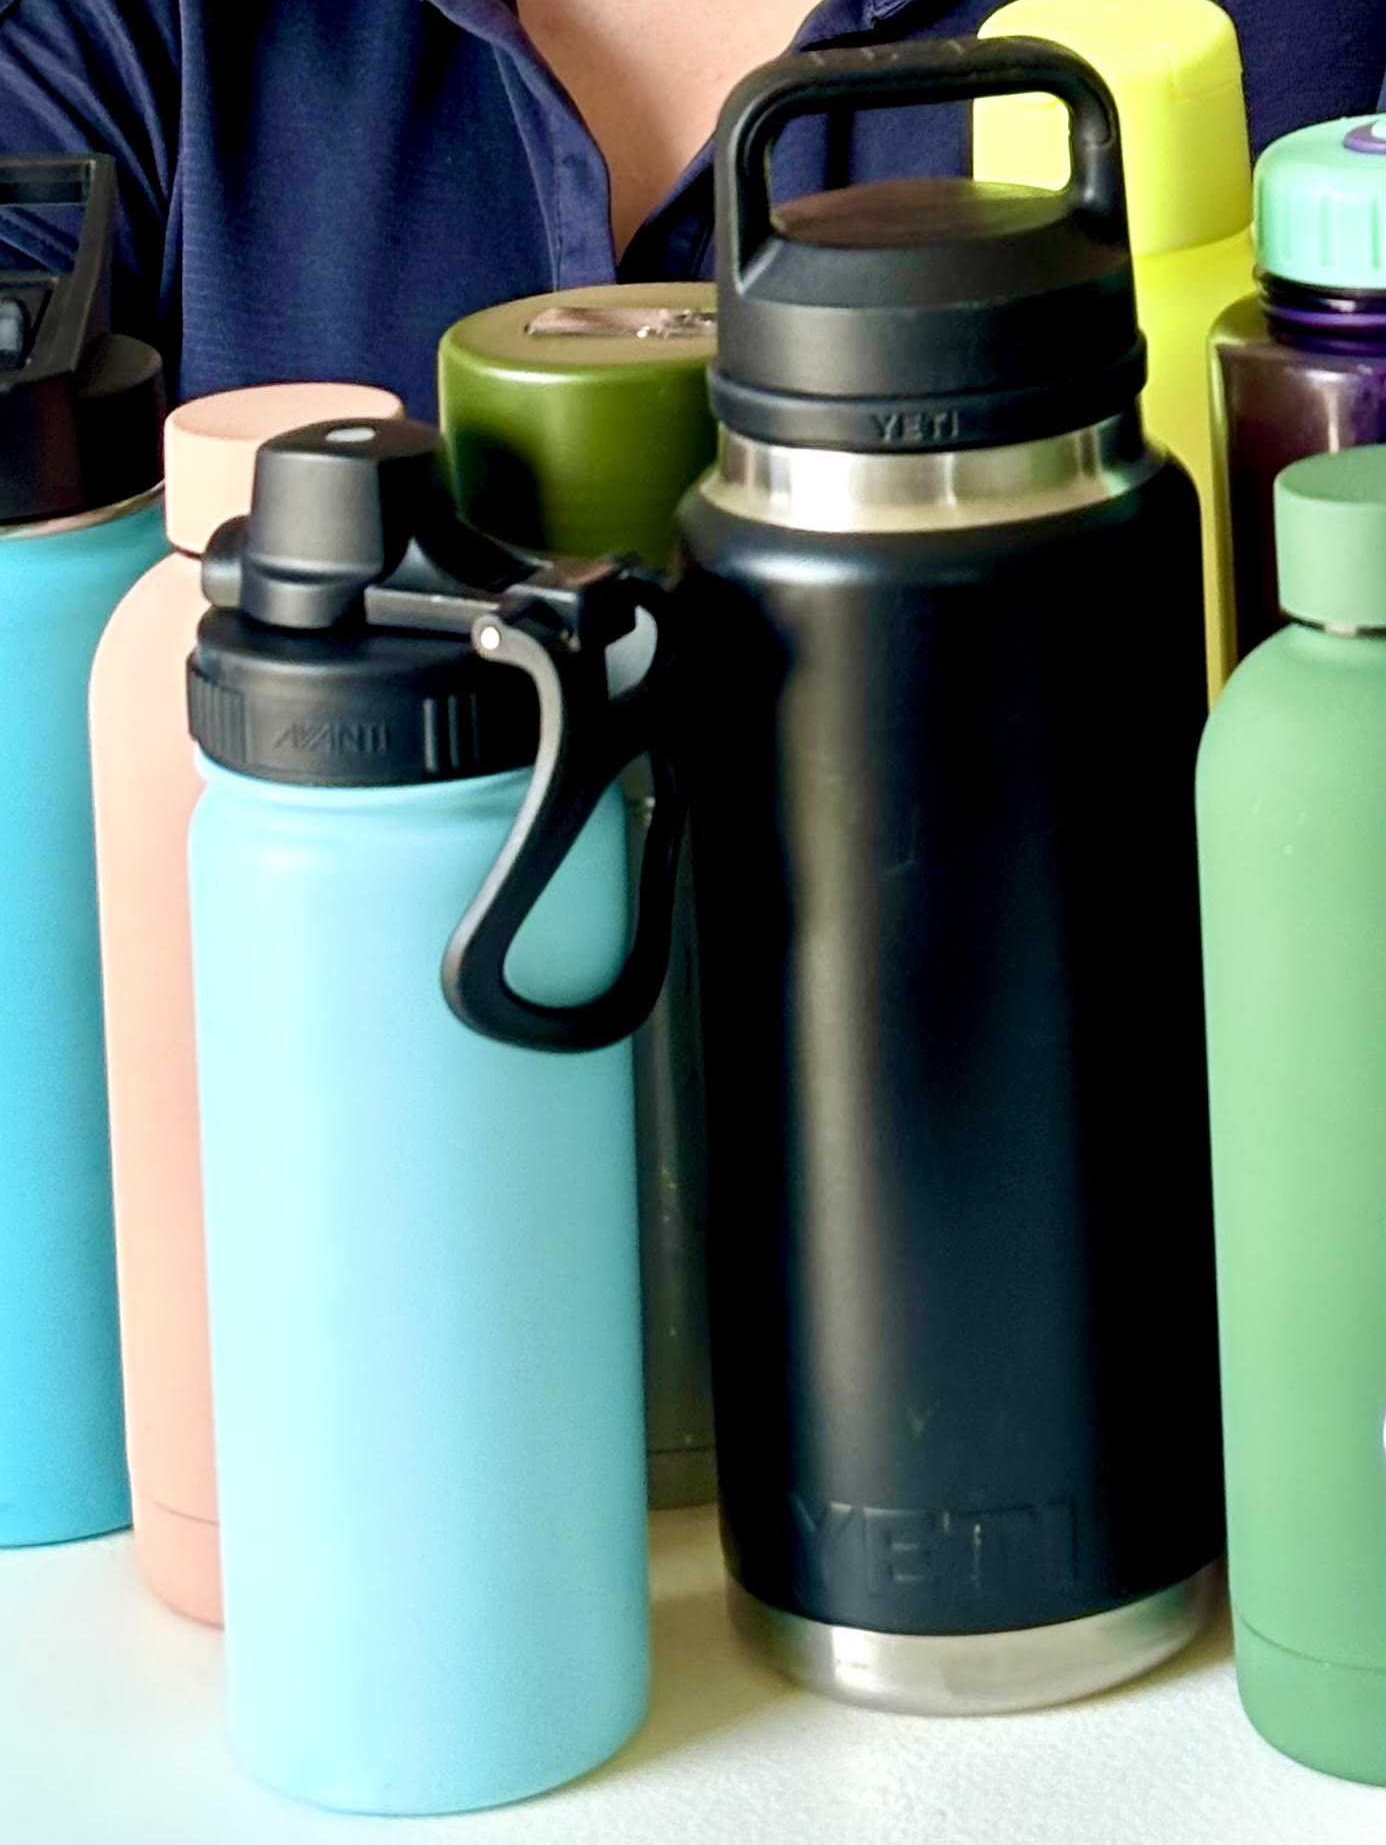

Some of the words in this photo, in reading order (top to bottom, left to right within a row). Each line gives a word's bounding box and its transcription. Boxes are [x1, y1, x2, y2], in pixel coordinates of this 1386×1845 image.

[871, 411, 959, 443] YETI
[273, 720, 390, 754] AVANTI
[790, 1493, 1079, 1601] YETI
